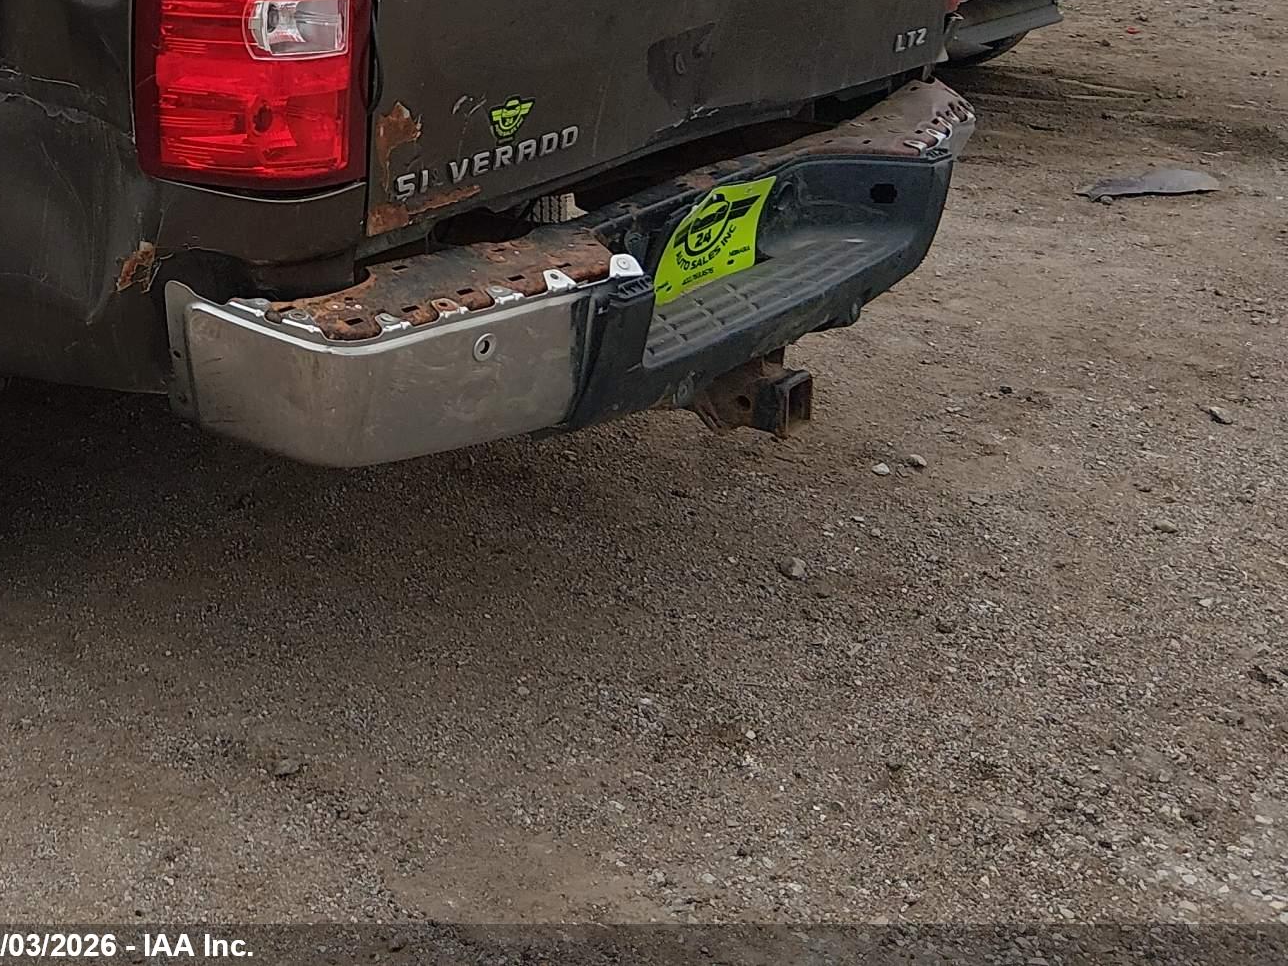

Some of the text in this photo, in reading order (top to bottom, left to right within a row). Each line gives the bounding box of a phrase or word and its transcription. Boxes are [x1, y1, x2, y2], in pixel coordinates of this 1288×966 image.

[895, 27, 928, 53] LTZ
[396, 126, 579, 201] SIVERADO
[675, 225, 736, 271] AUTO SALES INC
[694, 229, 712, 248] 24
